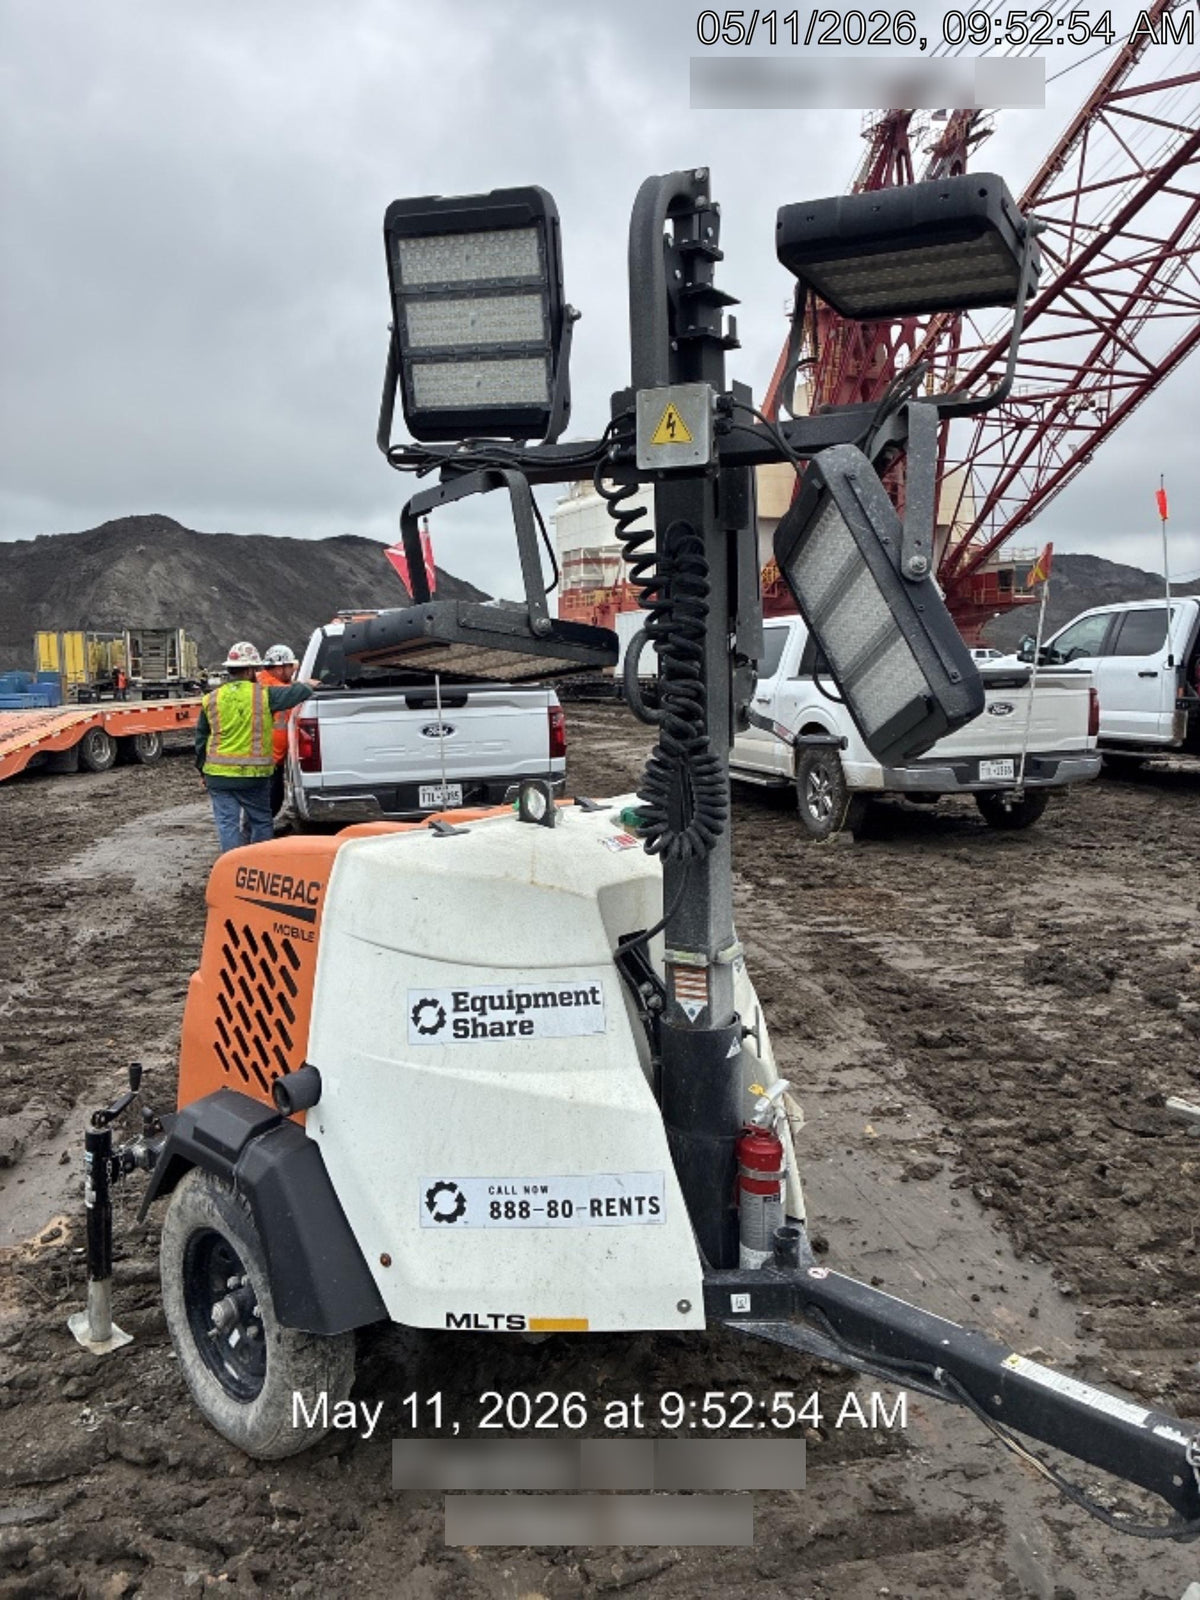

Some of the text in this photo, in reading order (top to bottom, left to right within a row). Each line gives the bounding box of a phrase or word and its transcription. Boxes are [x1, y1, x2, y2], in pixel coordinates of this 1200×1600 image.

[235, 866, 321, 905] GENERAC
[273, 922, 315, 943] MOBILE
[452, 986, 601, 1017] Equipment
[452, 1017, 535, 1039] Share
[488, 1185, 549, 1196] CALL NOW
[489, 1196, 661, 1220] 888-80-RENTS
[445, 1312, 526, 1331] MLTS
